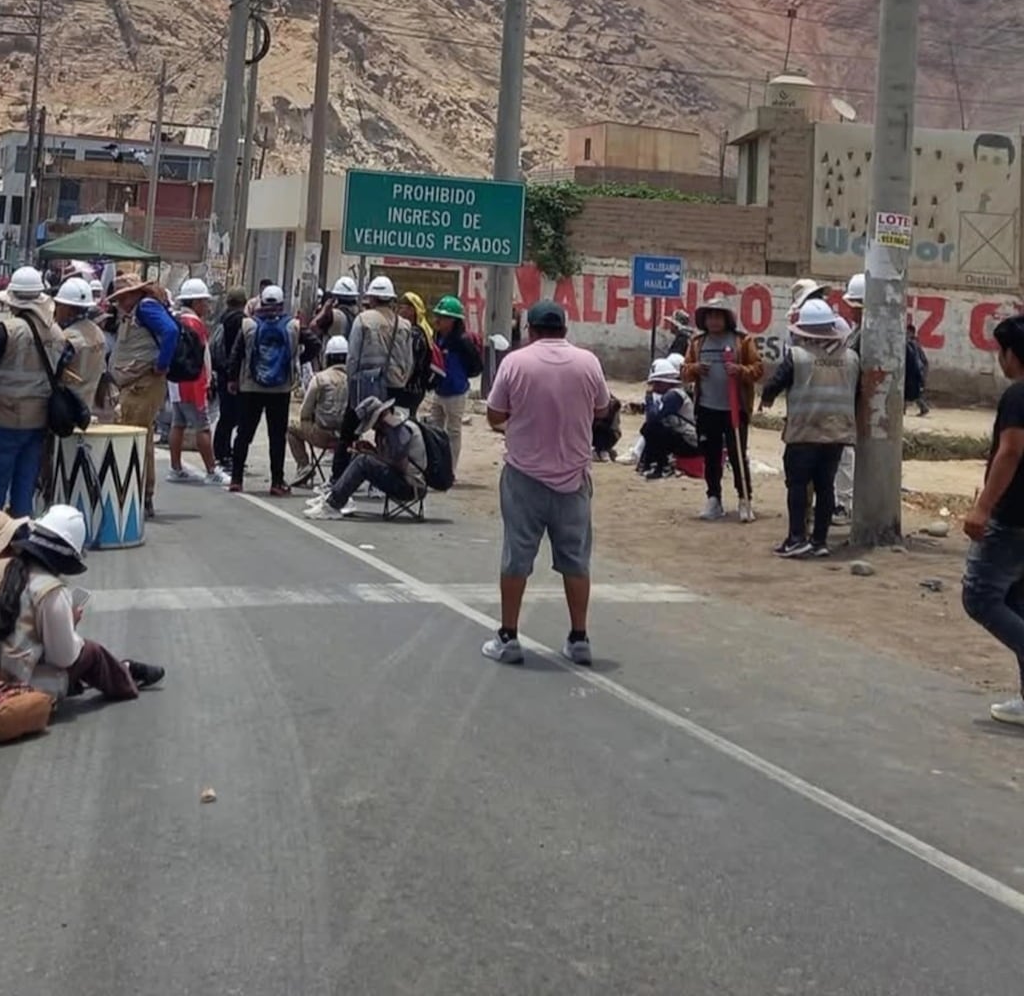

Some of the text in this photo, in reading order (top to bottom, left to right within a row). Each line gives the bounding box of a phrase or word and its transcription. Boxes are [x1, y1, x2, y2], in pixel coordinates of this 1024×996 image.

[393, 184, 476, 206] PROHIBIDO
[388, 207, 482, 230] INGRESO DE
[354, 228, 511, 255] VEHICULOS PESADOS
